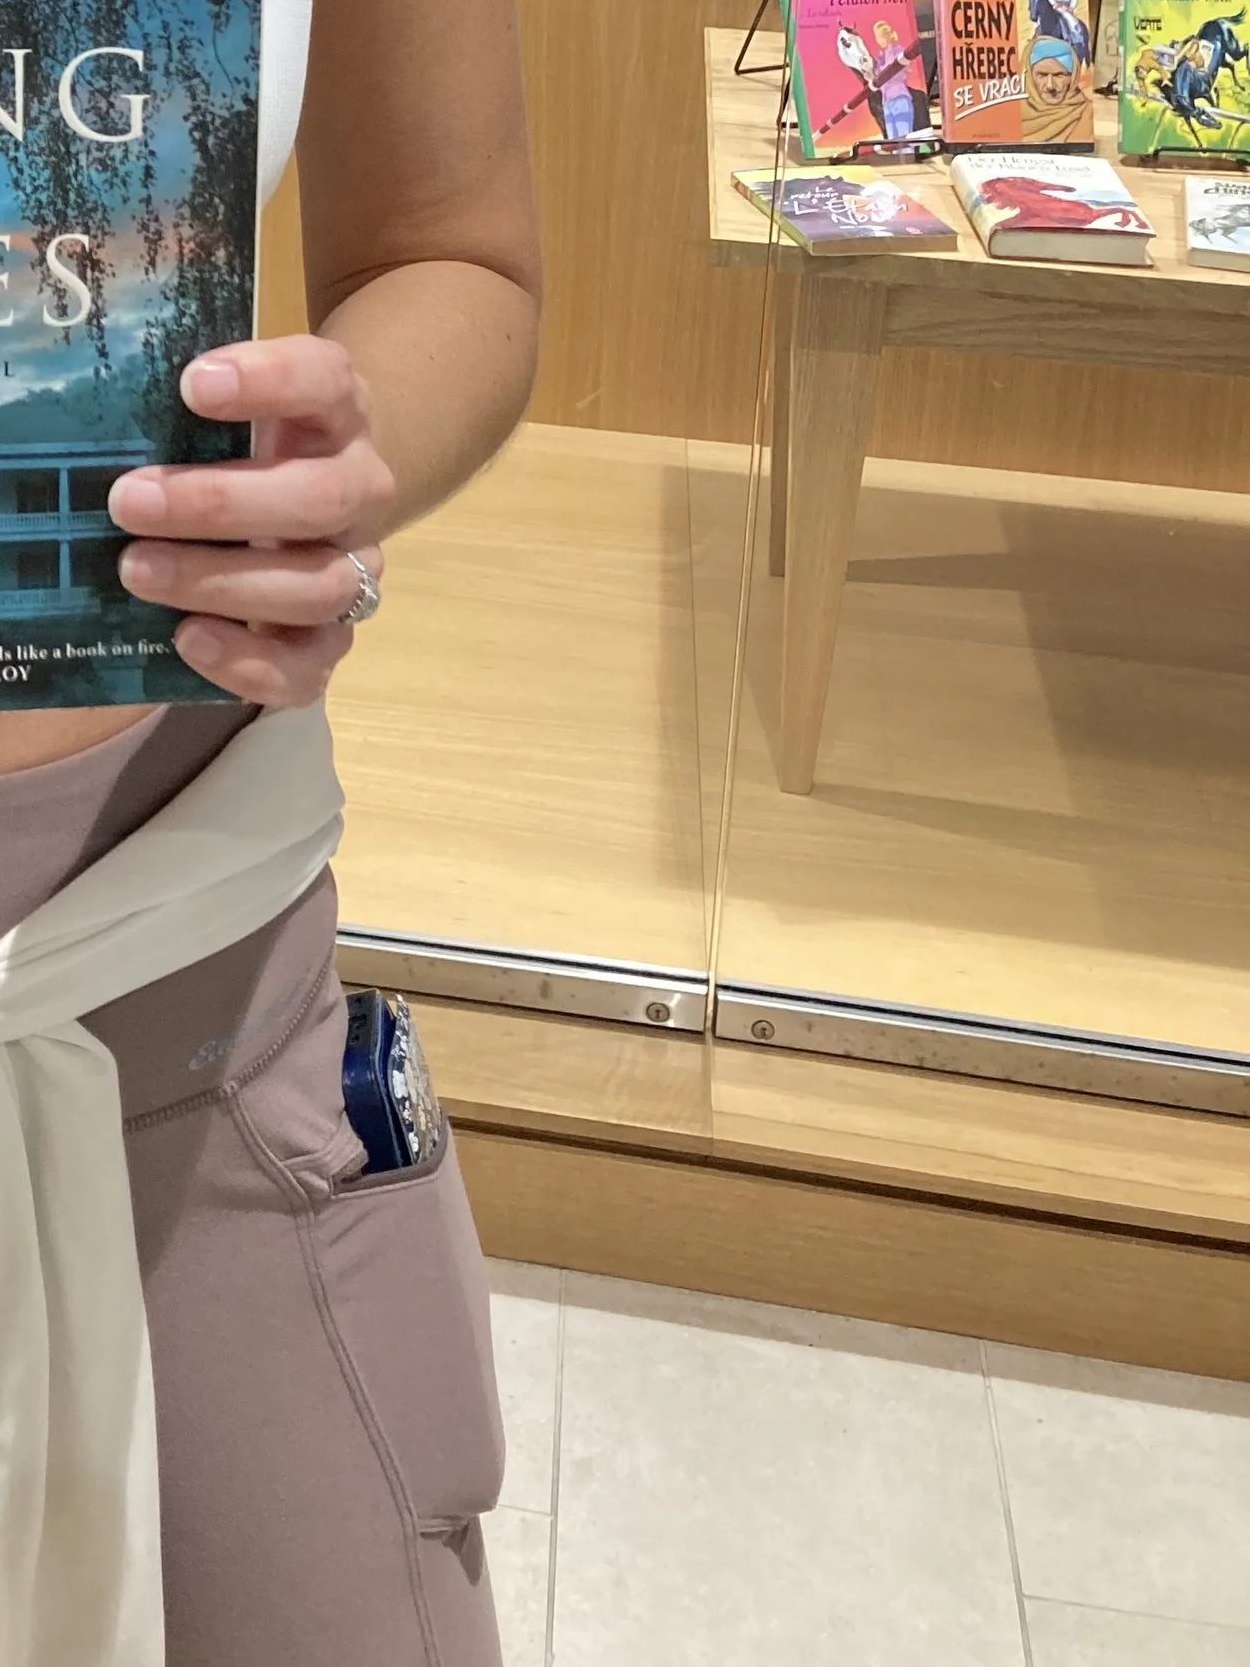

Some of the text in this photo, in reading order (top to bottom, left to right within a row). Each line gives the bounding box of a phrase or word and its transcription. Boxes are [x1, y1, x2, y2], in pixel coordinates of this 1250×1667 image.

[952, 42, 1017, 80] HŘEBEC
[954, 85, 974, 108] SE
[17, 644, 48, 661] like
[52, 649, 62, 659] a
[66, 642, 107, 657] book
[112, 644, 133, 655] on
